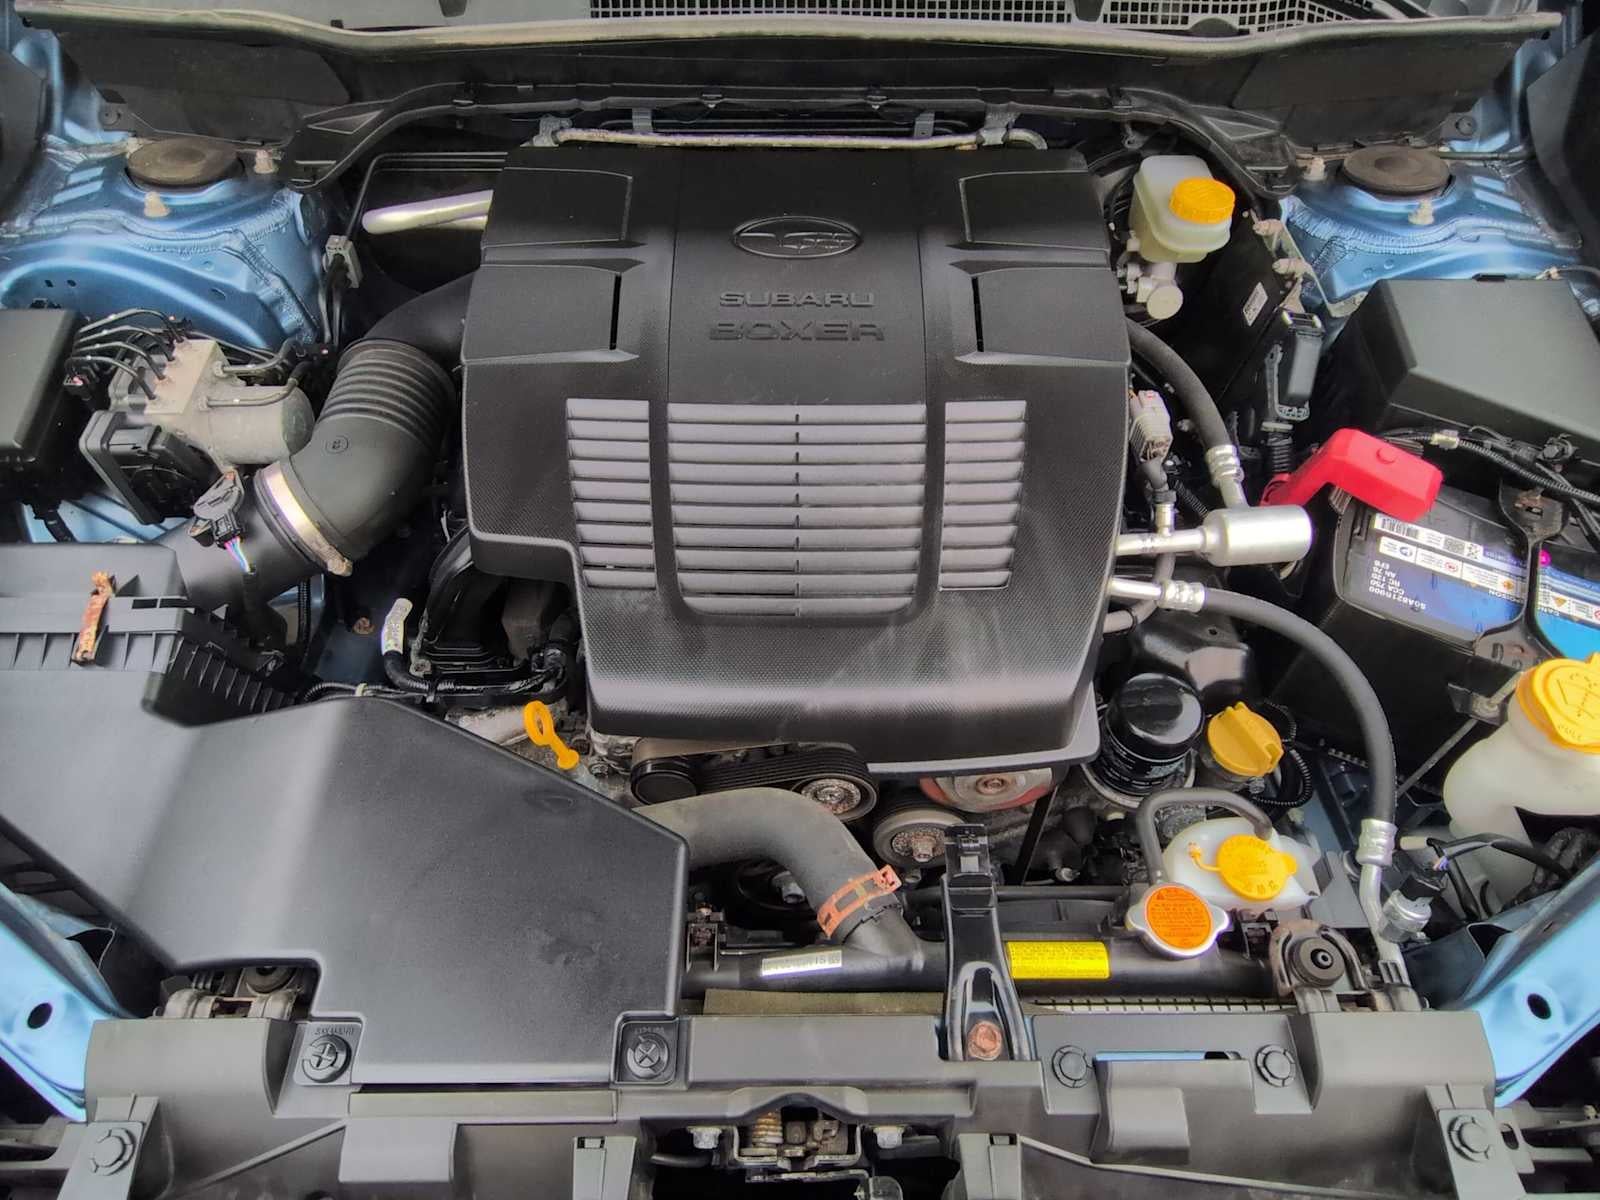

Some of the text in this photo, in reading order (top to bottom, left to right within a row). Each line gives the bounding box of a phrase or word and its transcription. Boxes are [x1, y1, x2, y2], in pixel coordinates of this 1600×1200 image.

[719, 291, 875, 308] SUBARU
[709, 320, 885, 342] BOXER
[1387, 585, 1405, 596] CCA
